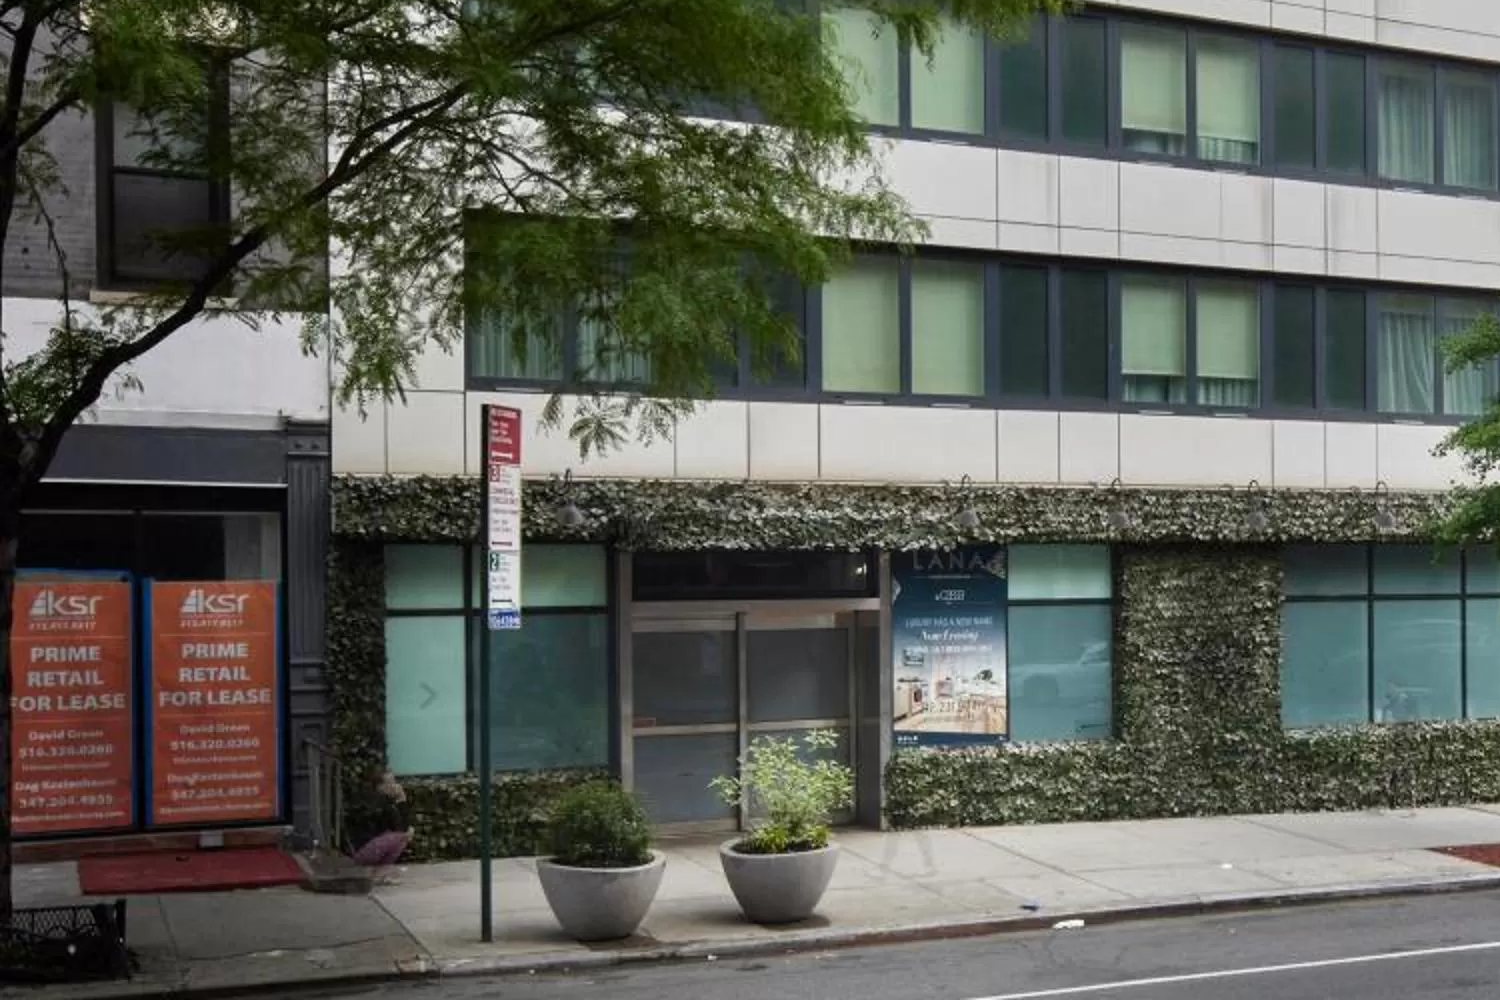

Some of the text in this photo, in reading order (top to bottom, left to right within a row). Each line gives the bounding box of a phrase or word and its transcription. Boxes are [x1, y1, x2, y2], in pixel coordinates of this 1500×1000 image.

[912, 551, 985, 571] LANA
[31, 646, 102, 662] PRIME
[182, 642, 249, 659] PRIME
[27, 668, 105, 687] RETAIL
[179, 665, 251, 683] RETAIL
[57, 692, 126, 711] LEASE
[159, 687, 272, 707] FOR LEASE
[28, 729, 65, 742] David
